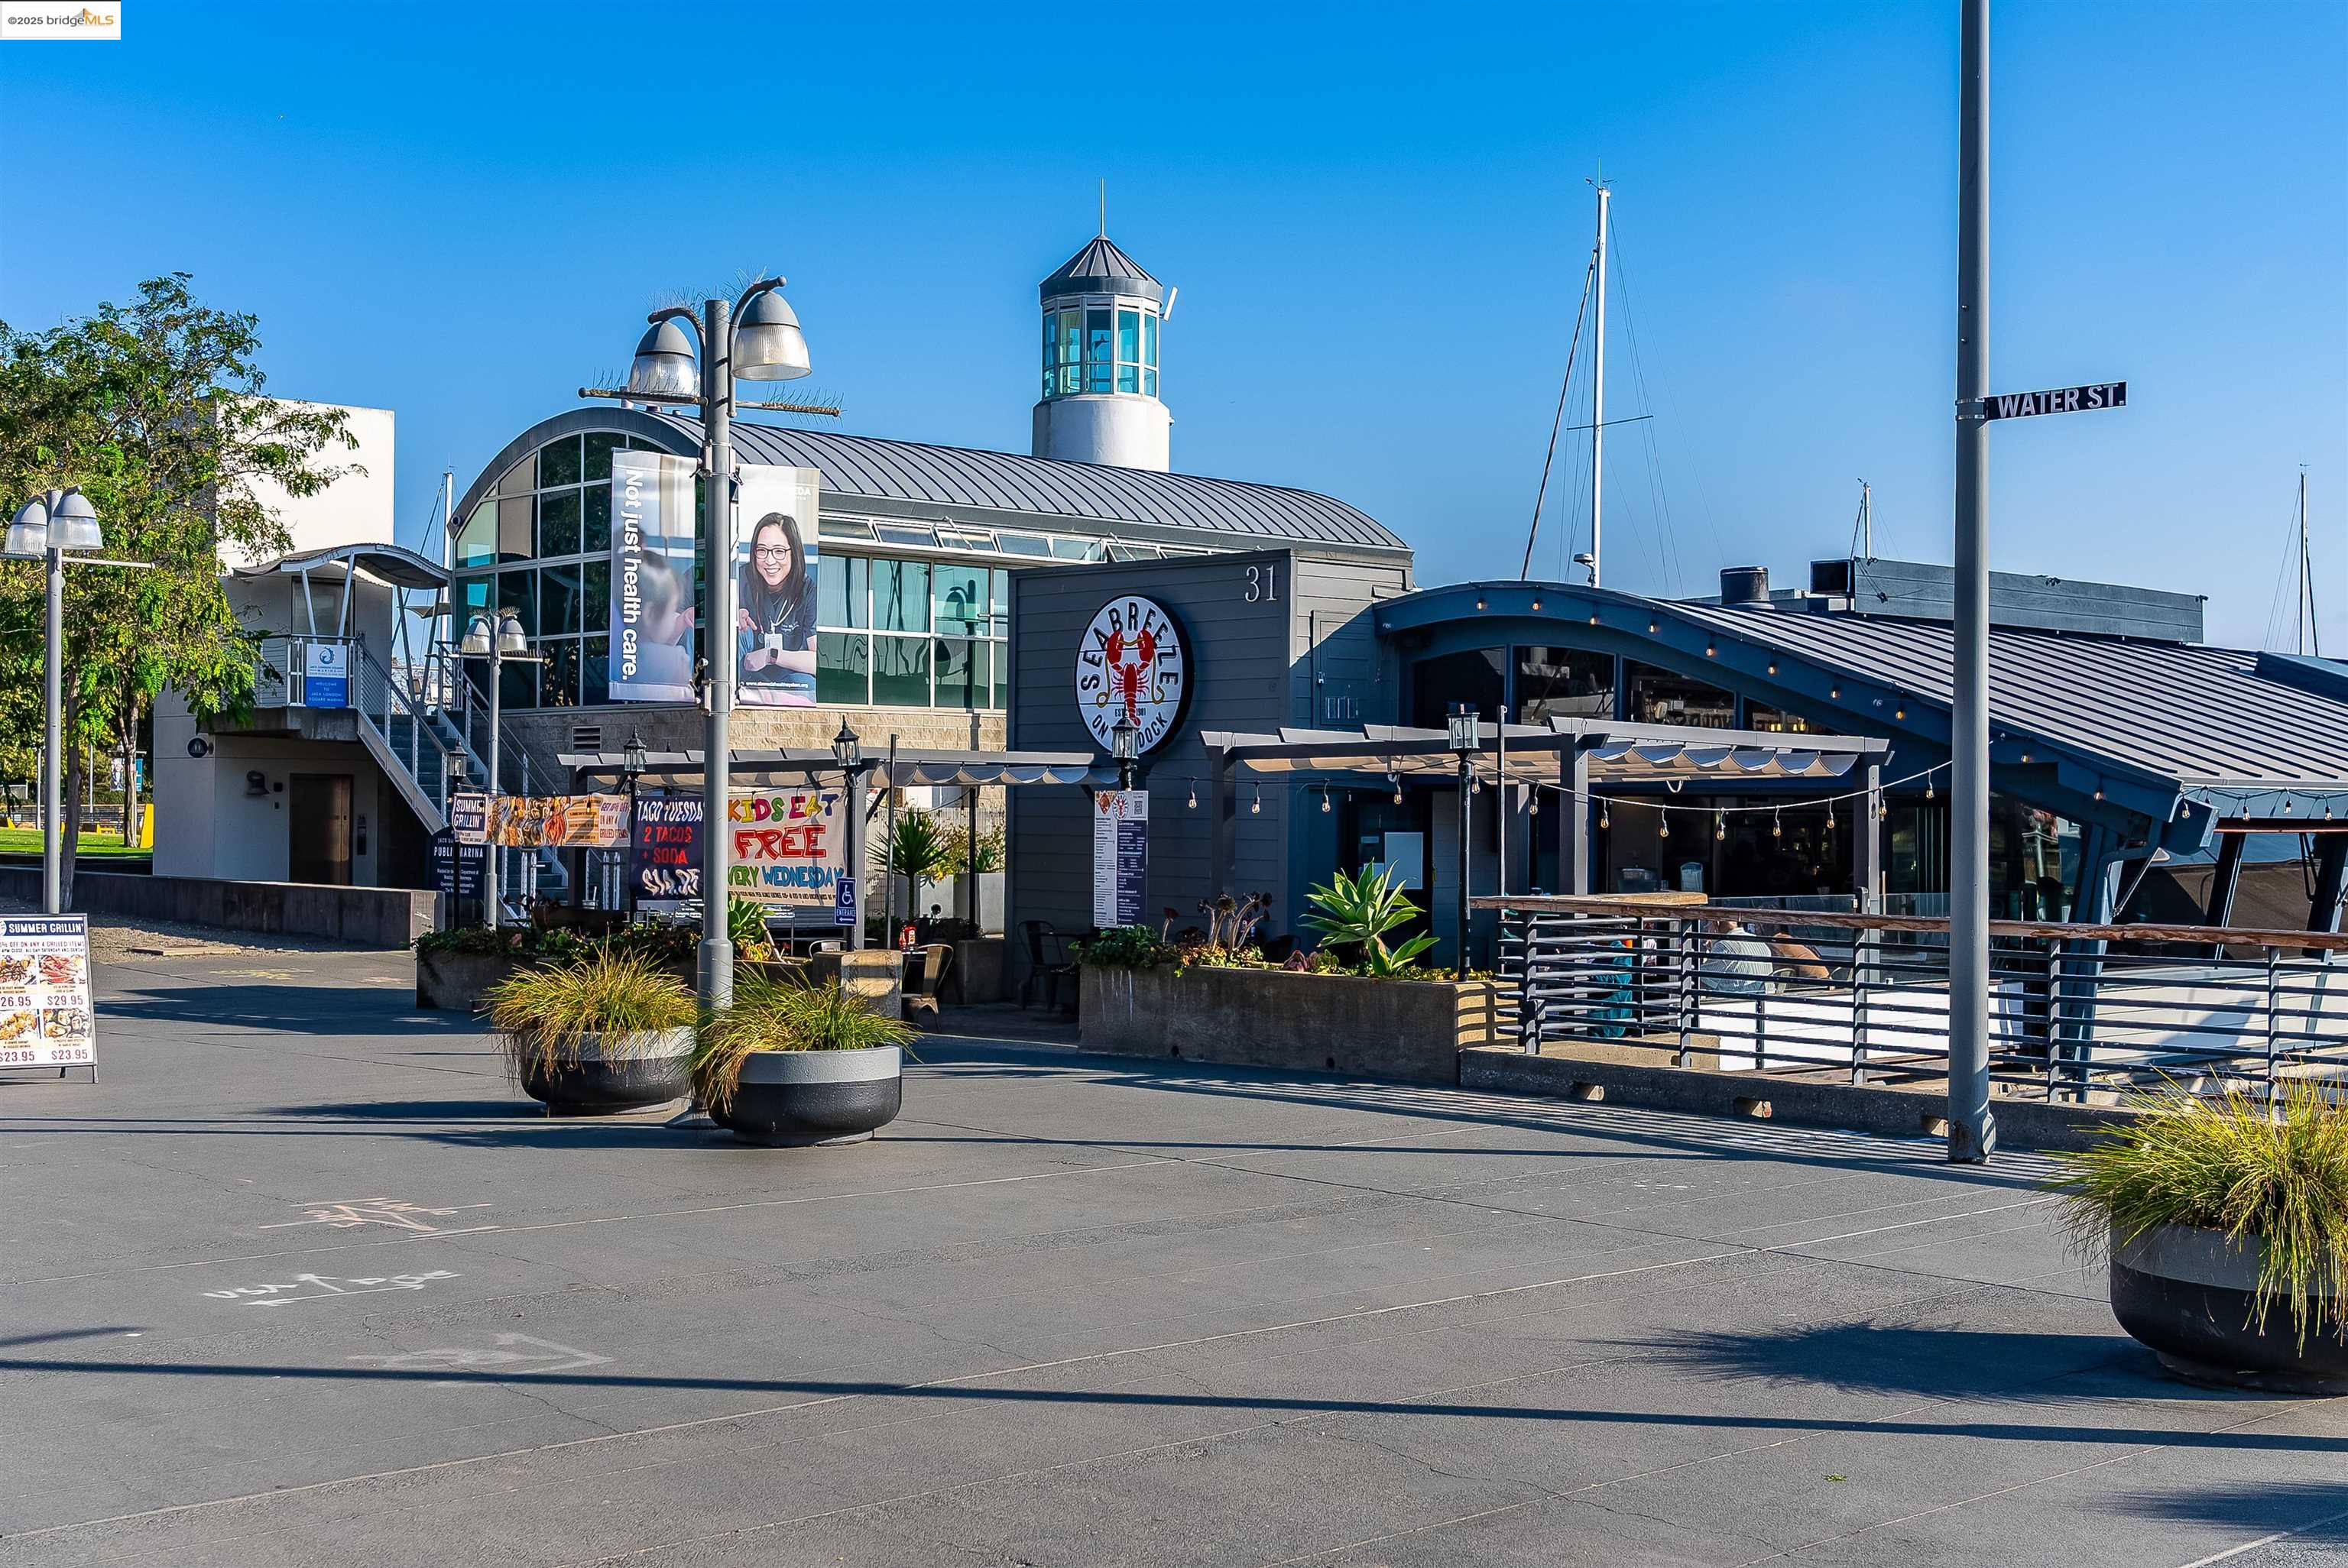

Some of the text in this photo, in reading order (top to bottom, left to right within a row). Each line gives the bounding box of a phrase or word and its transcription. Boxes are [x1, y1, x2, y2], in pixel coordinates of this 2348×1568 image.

[1997, 383, 2125, 419] WATER ST.
[620, 469, 643, 682] Not just health care.
[1244, 564, 1277, 602] 31
[1081, 601, 1179, 691] SEABREEZE
[1092, 711, 1169, 747] ON DOCK
[637, 800, 705, 822] TACO TUESDA
[728, 793, 839, 823] KIDS EAT
[644, 826, 693, 844] 2 TACOS
[734, 824, 827, 860] FREE
[433, 847, 452, 857] PUBLI
[653, 847, 689, 865] SODA
[728, 865, 845, 889] VERY WEDNESDAY
[8, 922, 84, 933] SUMMER GRILLIN'
[0, 995, 83, 1007] 26.95 $29.95
[51, 1049, 88, 1061] $23.95
